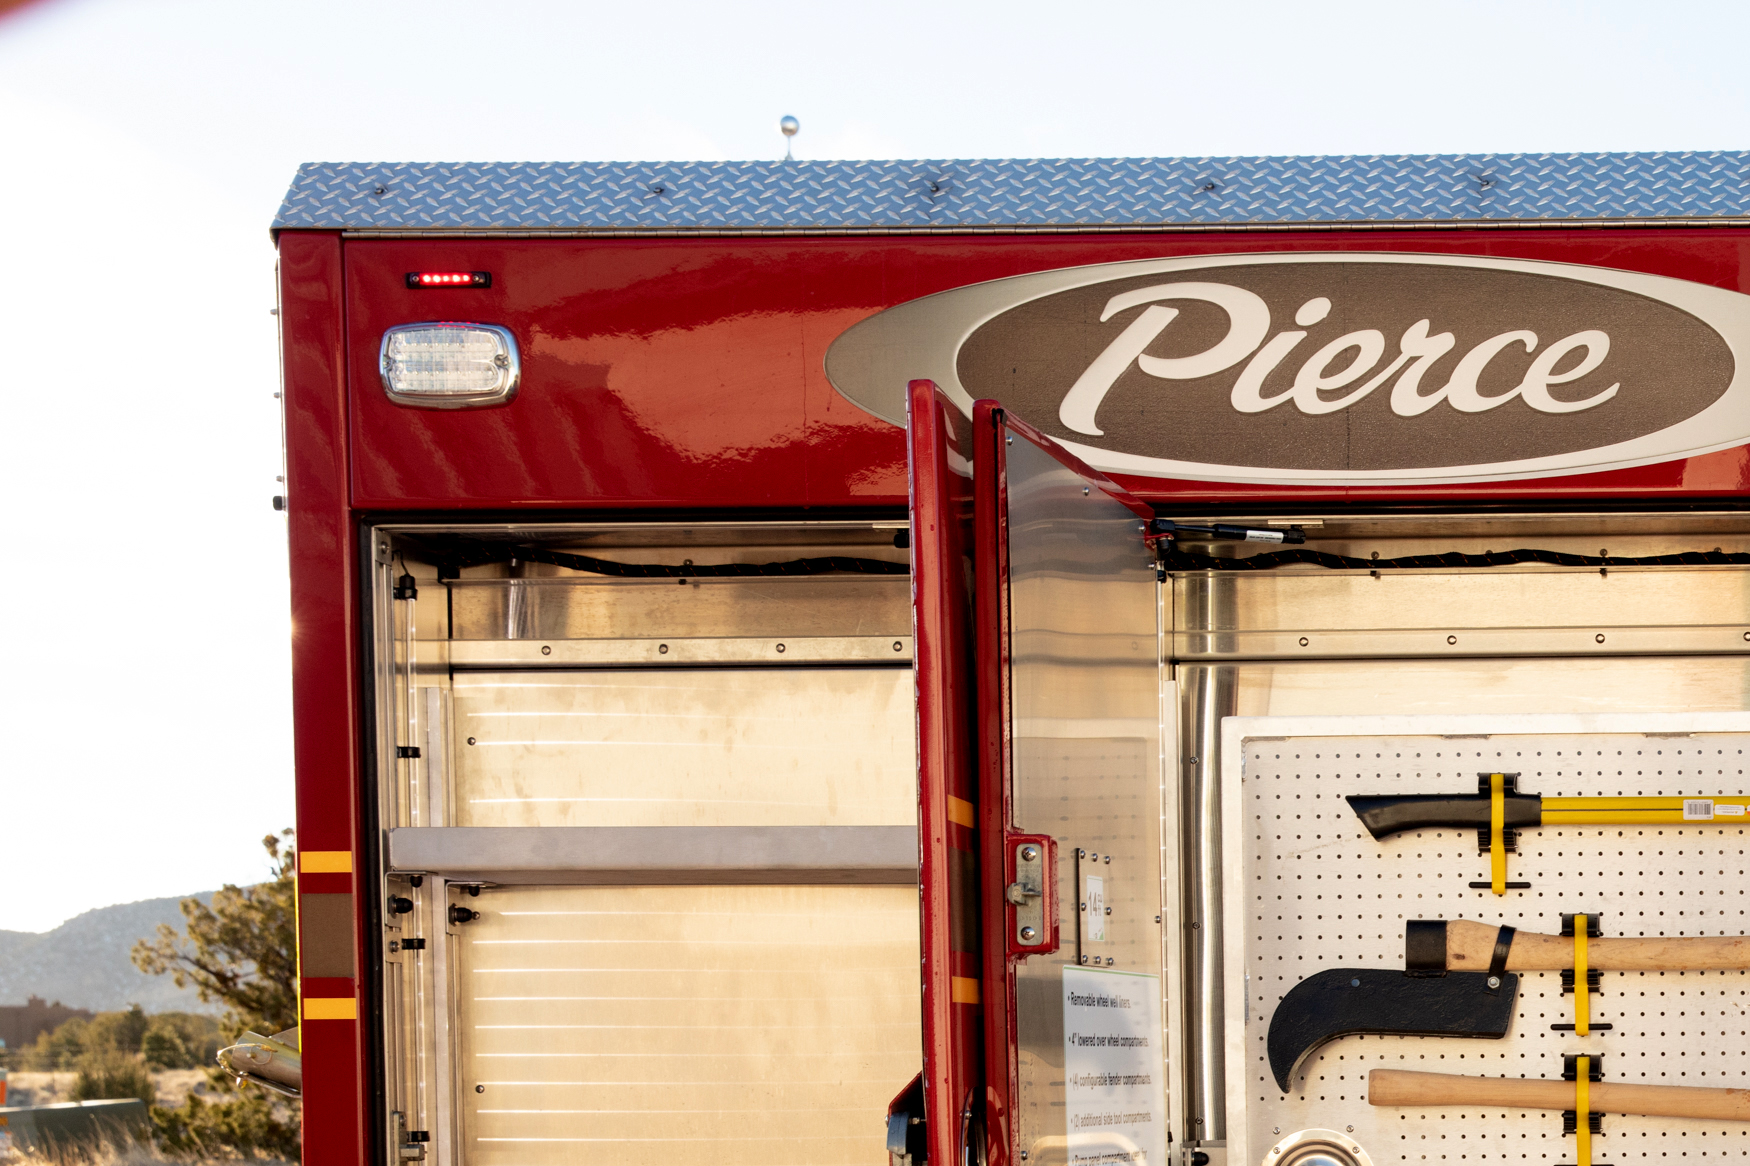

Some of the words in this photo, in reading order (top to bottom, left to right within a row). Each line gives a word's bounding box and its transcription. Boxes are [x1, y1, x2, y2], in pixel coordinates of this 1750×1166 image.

[1059, 281, 1620, 436] Pierce
[1088, 891, 1098, 917] 14
[1071, 991, 1096, 1007] Removable
[1096, 993, 1110, 1008] wheel
[1110, 994, 1118, 1008] well
[1078, 1033, 1096, 1047] lowered
[1096, 1036, 1107, 1047] over
[1107, 1033, 1120, 1047] wheel
[1120, 1035, 1149, 1050] compartments.
[1080, 1072, 1108, 1090] configurable
[1108, 1072, 1122, 1086] fender
[1123, 1072, 1152, 1088] compartments.
[1080, 1112, 1103, 1127] additional
[1103, 1111, 1113, 1125] side
[1113, 1111, 1122, 1124] tool
[1123, 1110, 1152, 1126] compartments.
[1101, 1150, 1131, 1166] compartment
